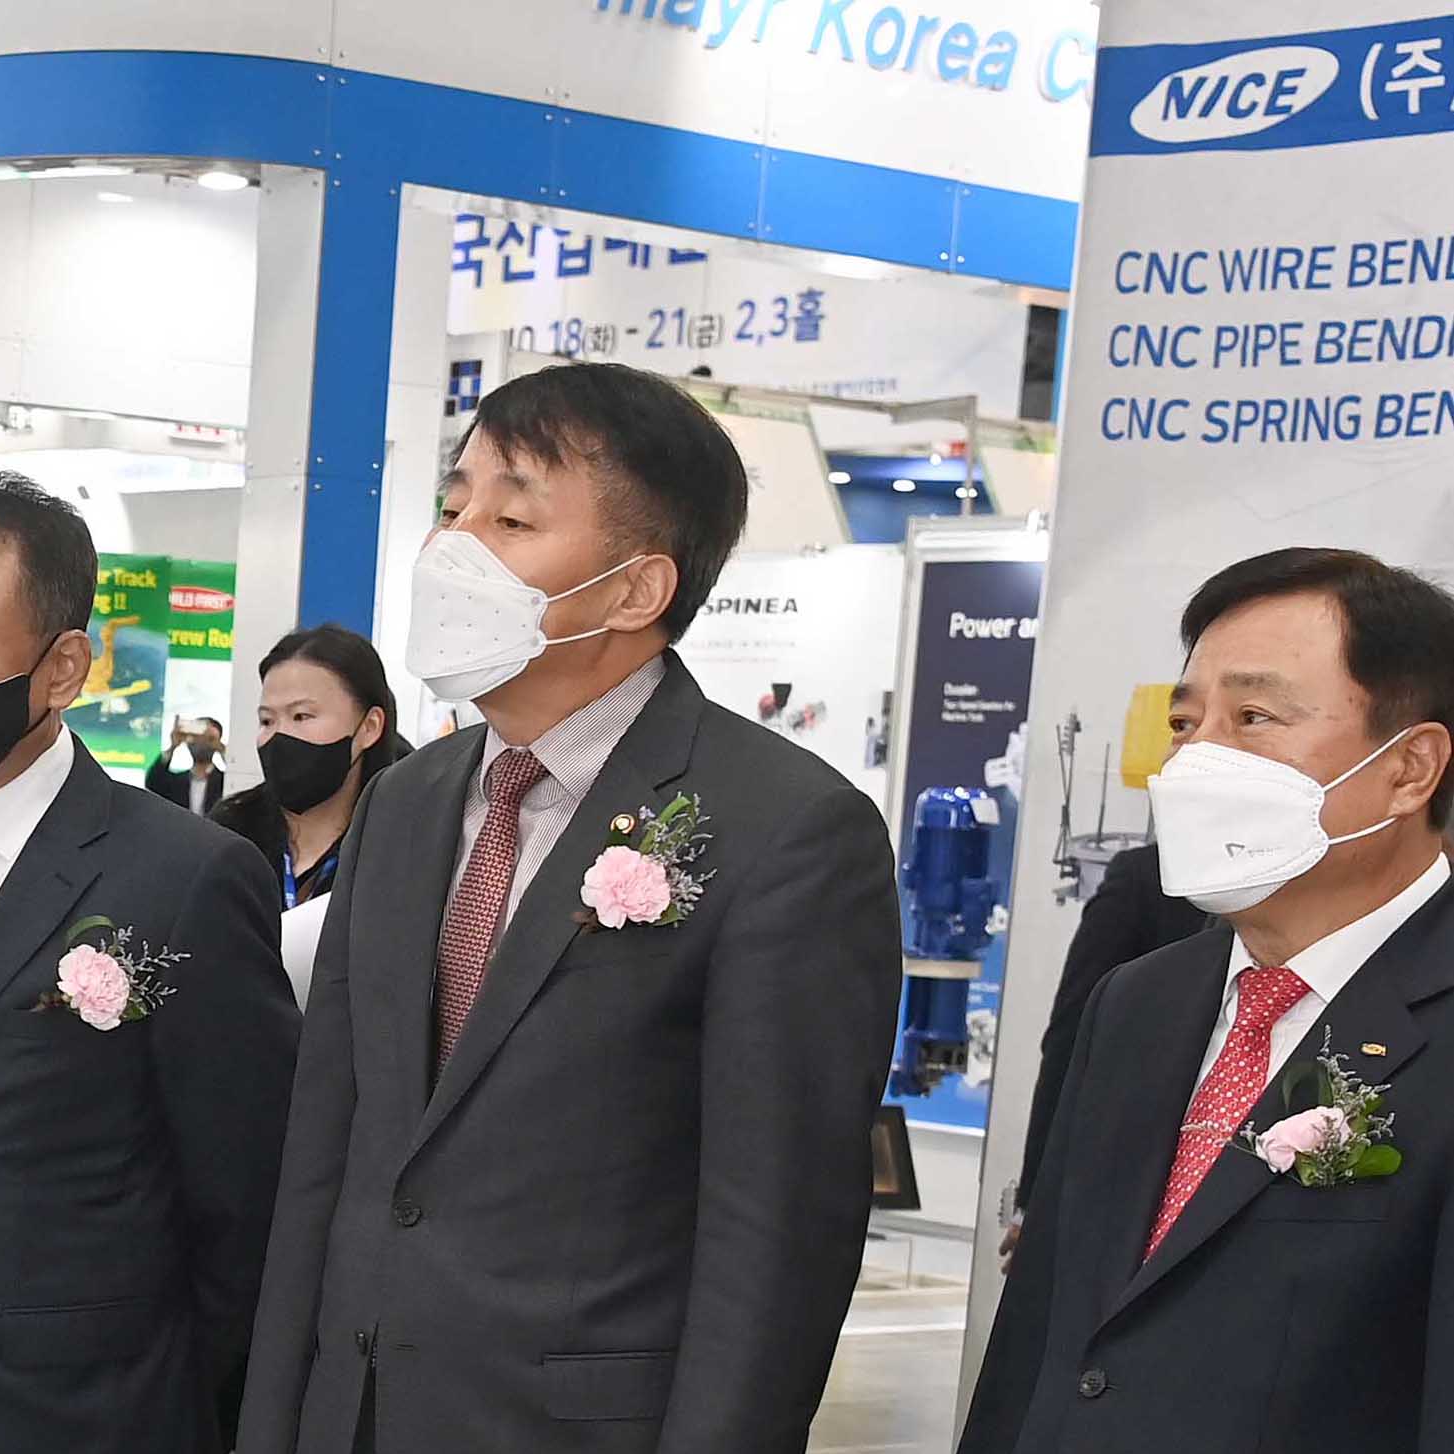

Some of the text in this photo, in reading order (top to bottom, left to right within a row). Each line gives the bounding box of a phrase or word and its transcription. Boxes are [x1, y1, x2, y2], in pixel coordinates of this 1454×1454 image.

[807, 0, 1018, 91] Korea
[1162, 67, 1307, 122] NICE
[1360, 37, 1454, 121] (주
[1114, 250, 1208, 295] CNC
[1219, 245, 1336, 293] WIRE
[1108, 324, 1201, 368] CNC
[1213, 321, 1304, 369] PIPE
[1101, 396, 1191, 442] CNC
[1201, 395, 1362, 443] SPRING
[949, 611, 1017, 639] Power
